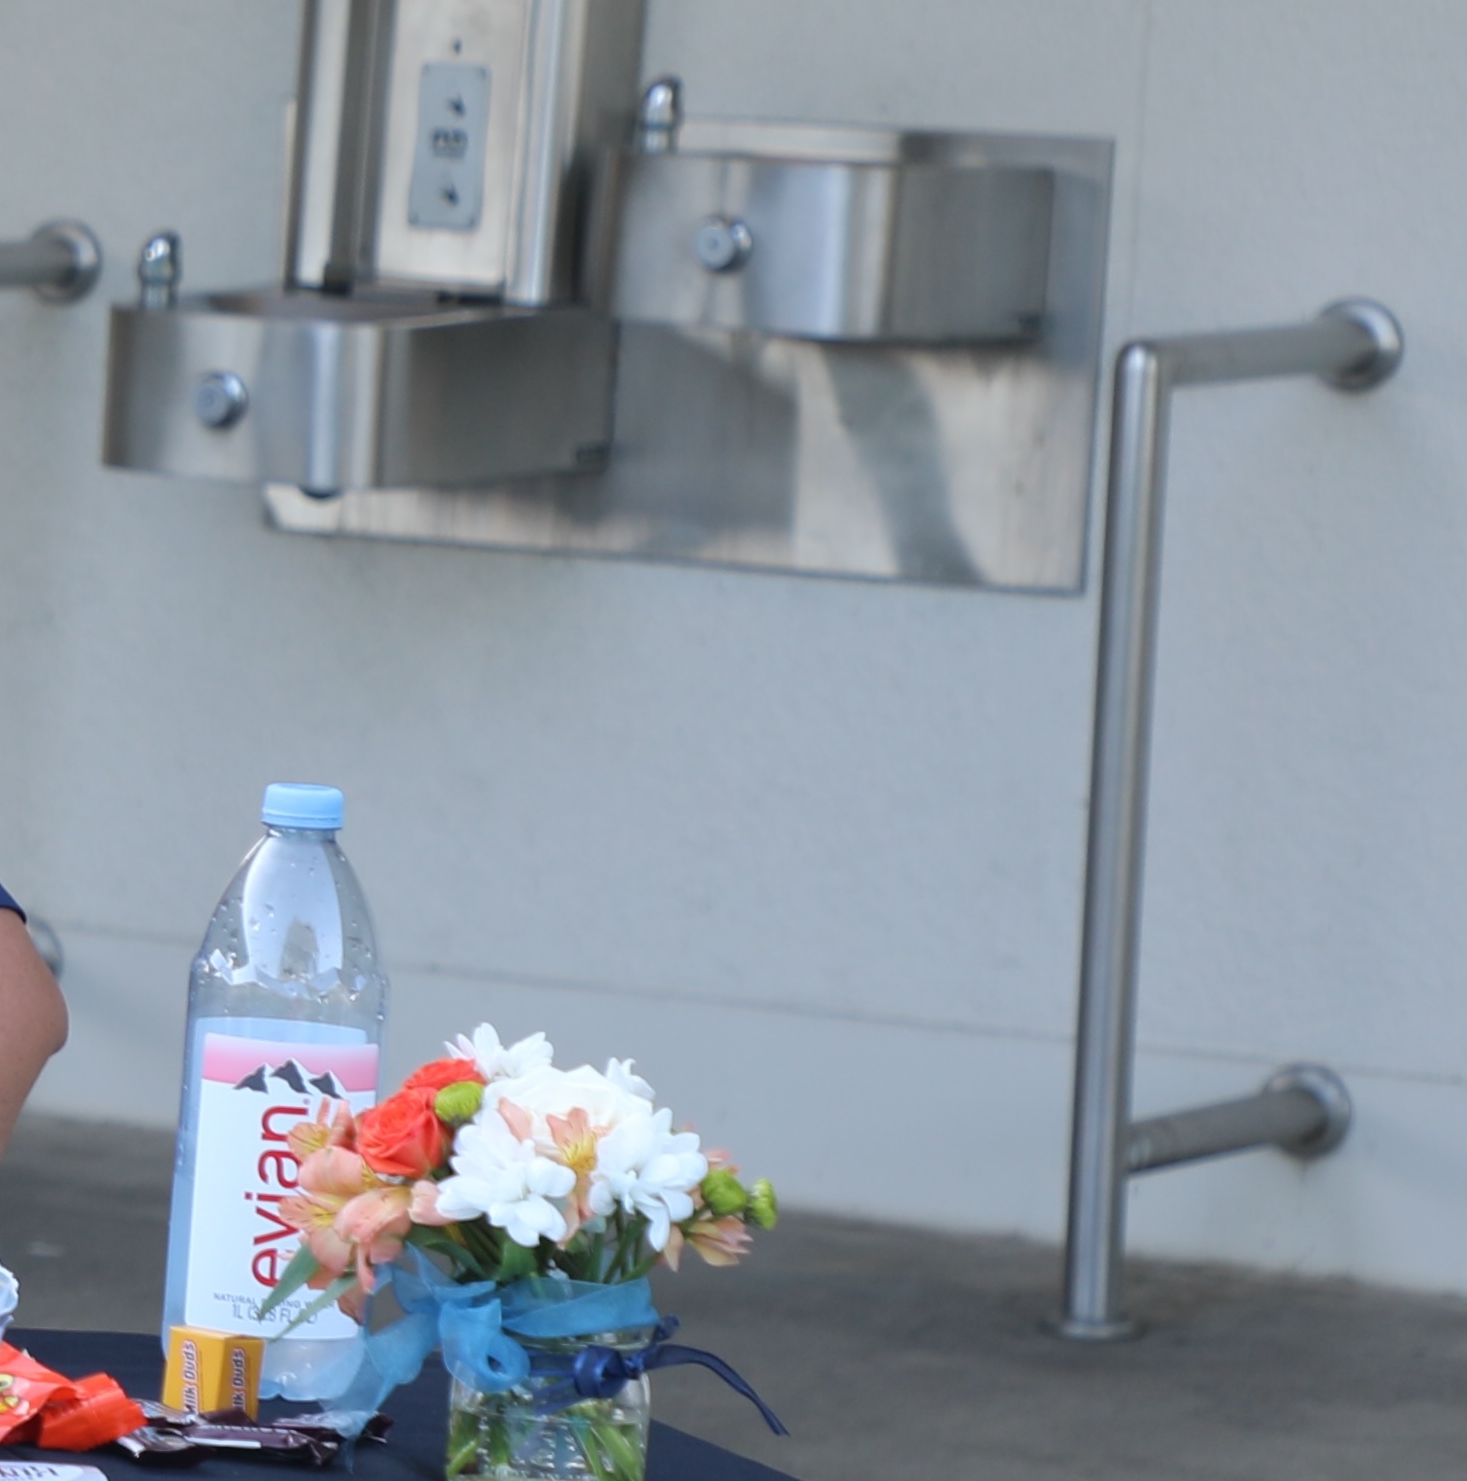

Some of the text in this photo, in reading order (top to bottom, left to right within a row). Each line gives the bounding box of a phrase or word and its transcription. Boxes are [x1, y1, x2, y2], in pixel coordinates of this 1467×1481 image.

[213, 1291, 256, 1307] NATURAL
[181, 1339, 198, 1382] Duds
[232, 1348, 246, 1389] Duds
